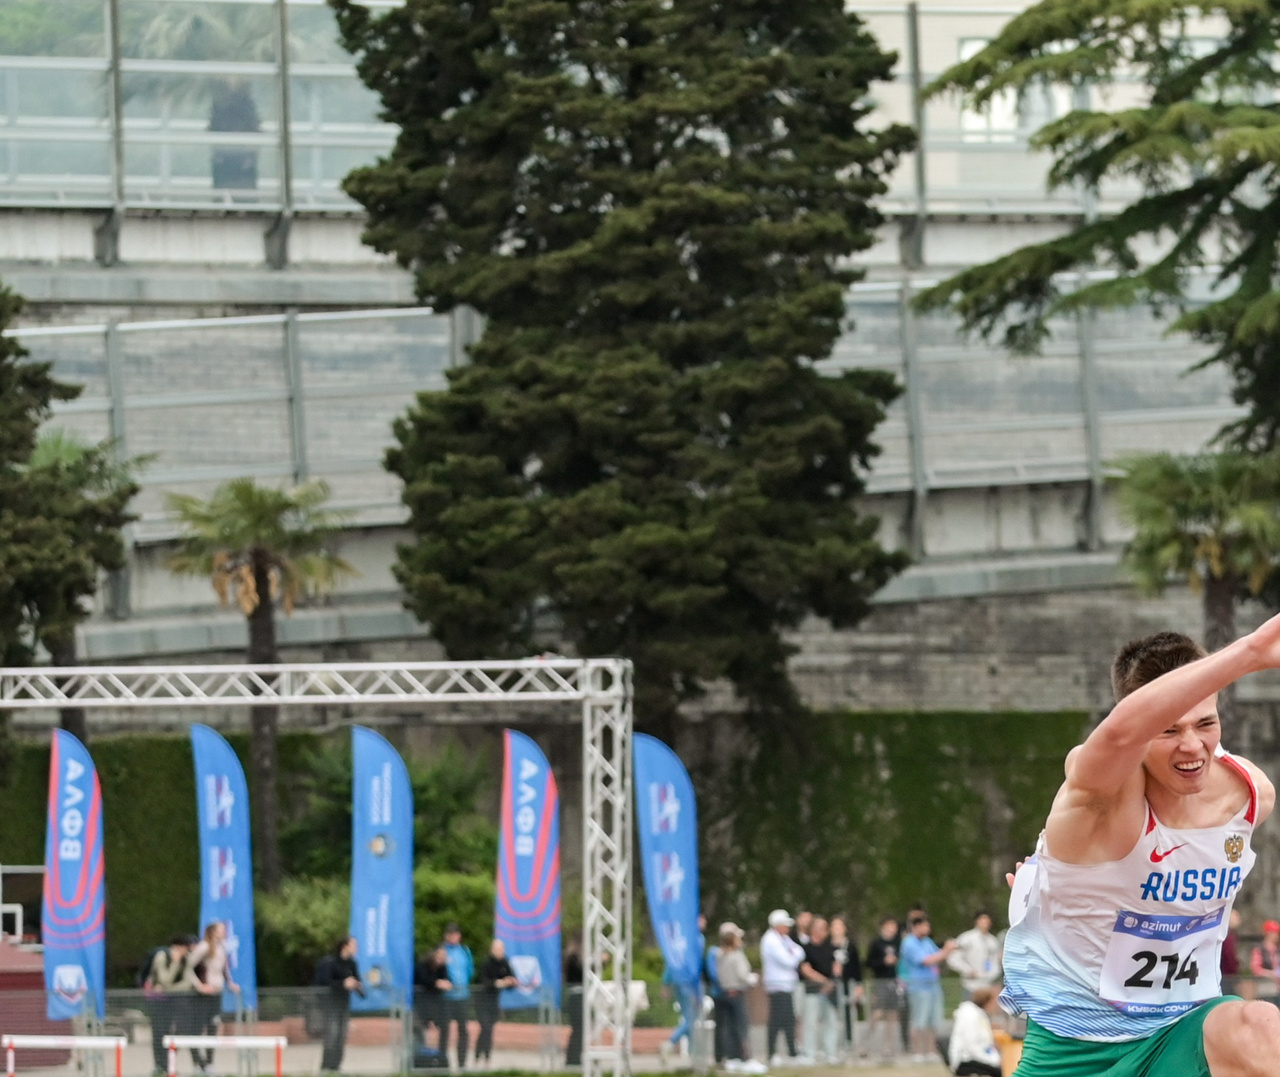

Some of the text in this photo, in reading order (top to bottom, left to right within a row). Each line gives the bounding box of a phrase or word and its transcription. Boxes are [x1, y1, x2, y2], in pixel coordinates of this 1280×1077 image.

[1140, 866, 1241, 903] RUSSIA
[1141, 920, 1182, 933] azimut
[1124, 947, 1200, 990] 214
